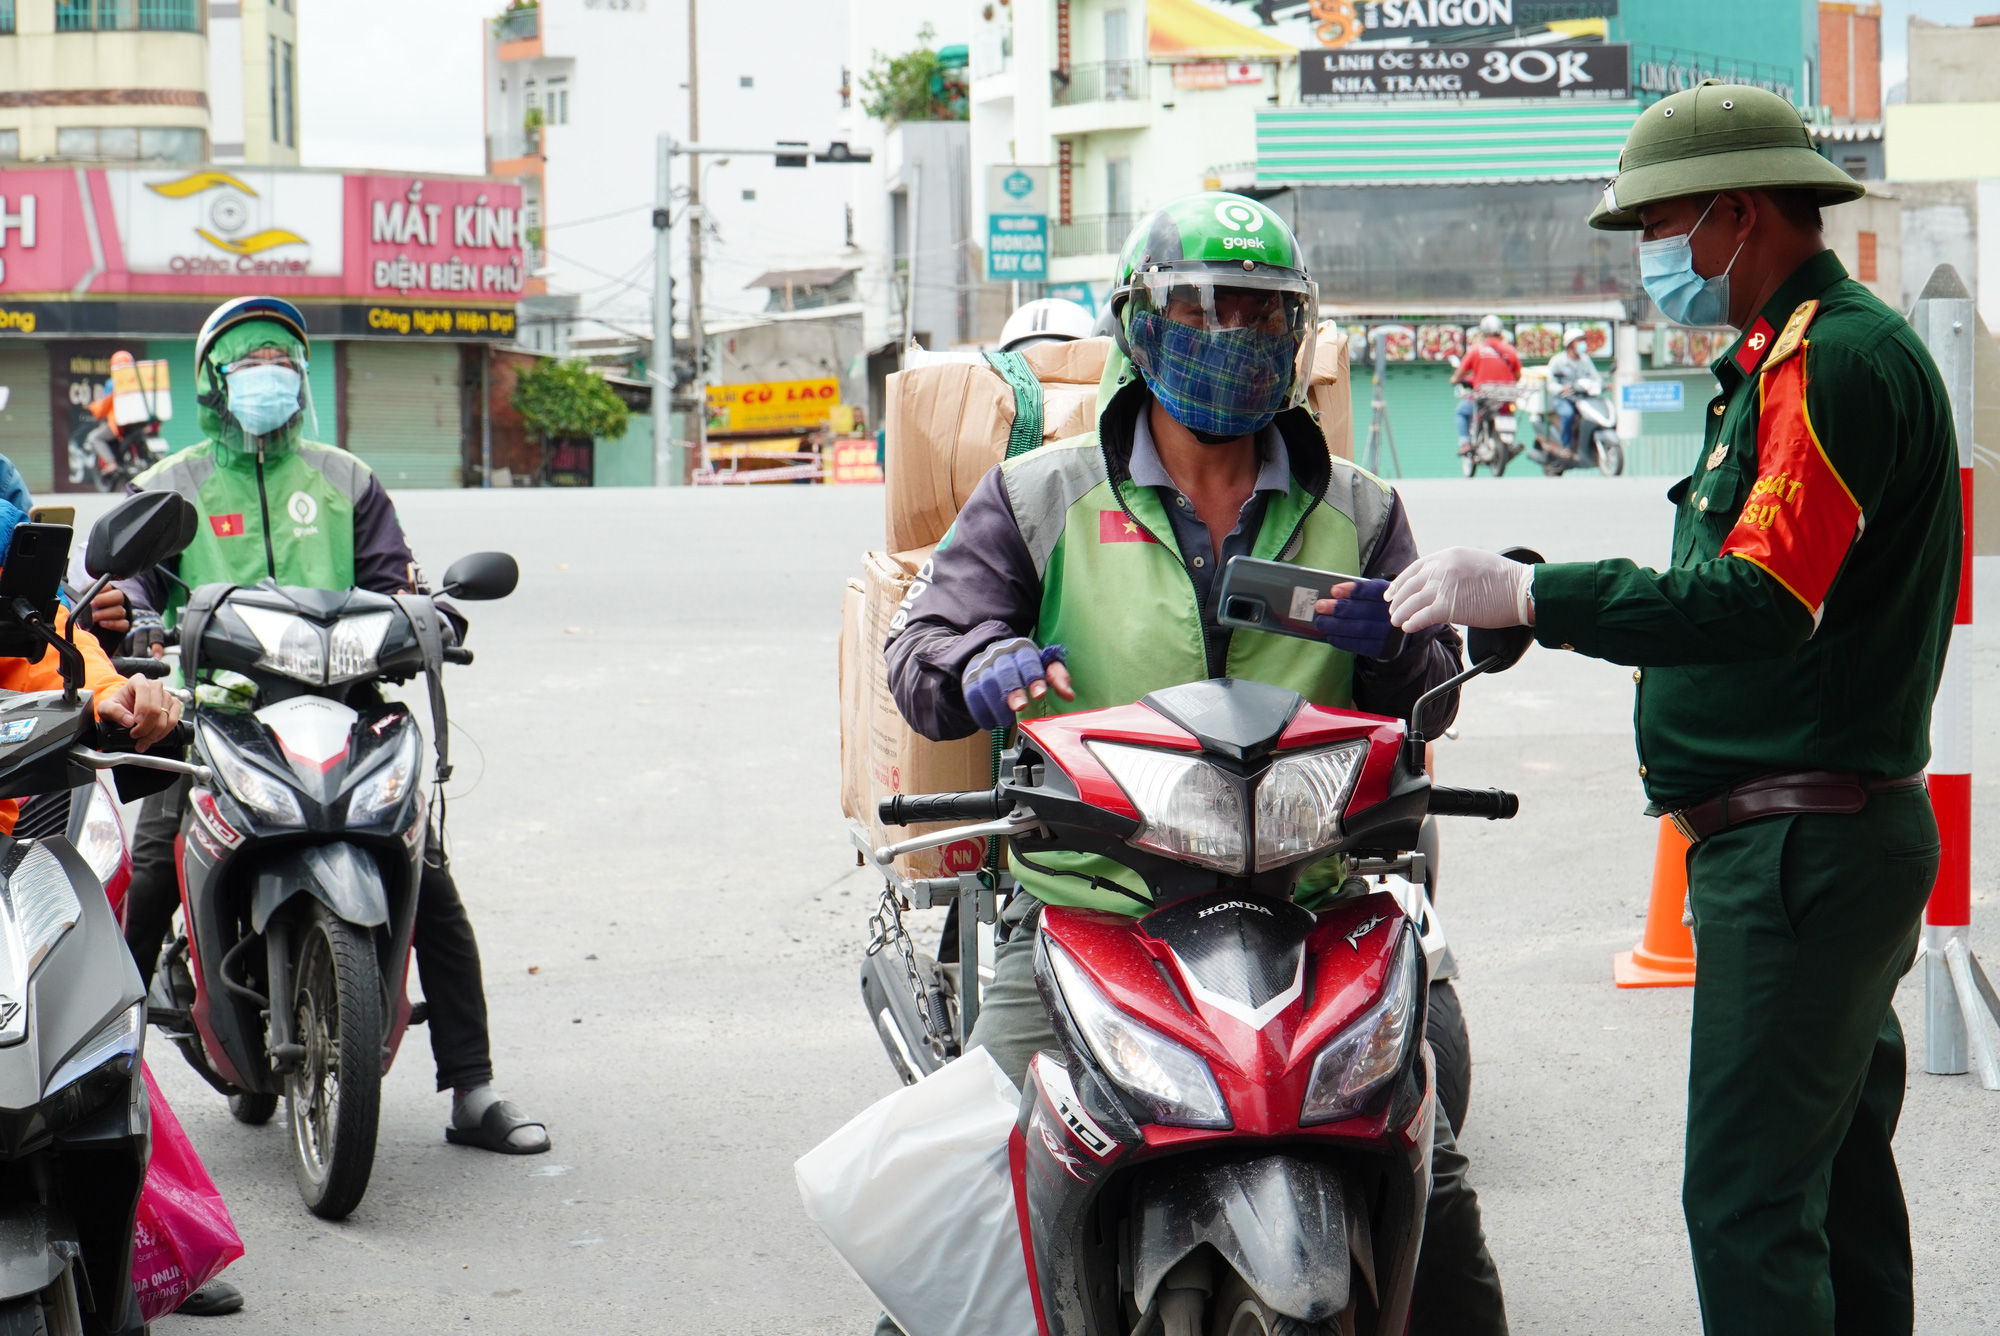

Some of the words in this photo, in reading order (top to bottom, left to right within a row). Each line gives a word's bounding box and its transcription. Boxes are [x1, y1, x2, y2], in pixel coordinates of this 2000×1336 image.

[1382, 0, 1513, 28] SAIGON
[1323, 54, 1375, 72] LINH
[1378, 50, 1415, 70] ỐC
[1418, 50, 1470, 70] XÀO
[1331, 77, 1376, 93] NHA
[1382, 74, 1462, 92] TRANG
[372, 180, 442, 245] MẮT
[454, 194, 524, 249] KÍNH
[991, 233, 1044, 252] HONDA
[1222, 236, 1266, 250] gojek
[236, 253, 310, 276] Center
[991, 253, 1020, 272] TAY
[1020, 253, 1043, 272] GA
[374, 254, 427, 295] ĐIỆN
[429, 255, 478, 291] BIÊN
[481, 256, 523, 292] PHỦ
[368, 308, 411, 334] Công
[786, 385, 835, 401] LAO
[952, 849, 972, 865] NN
[1198, 901, 1274, 919] HONDA
[1059, 1101, 1107, 1152] 110
[137, 1250, 154, 1262] Scan
